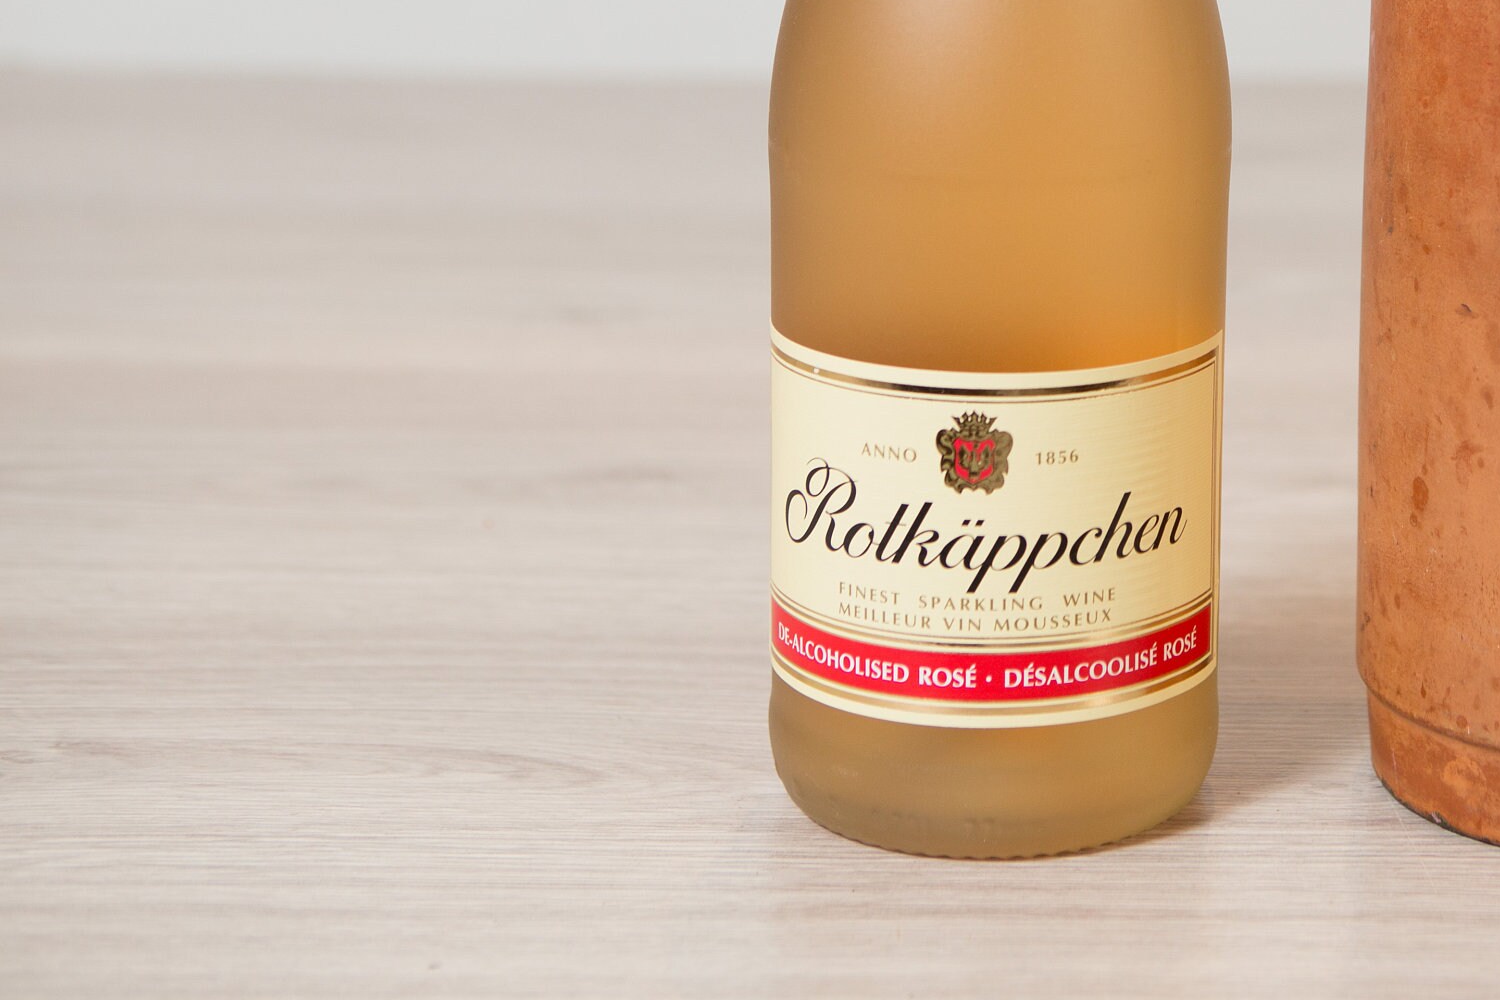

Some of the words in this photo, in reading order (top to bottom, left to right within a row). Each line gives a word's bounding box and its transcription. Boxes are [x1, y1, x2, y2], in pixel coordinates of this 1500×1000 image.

[860, 442, 918, 464] ANNO
[1035, 448, 1080, 467] 1856
[785, 456, 1188, 595] Rotkäppchen
[838, 581, 900, 606] FINEST
[918, 594, 1044, 613] SPARKLING
[1063, 586, 1117, 608] WINE
[838, 601, 931, 630] MEILLEUR
[943, 616, 982, 632] VIN
[993, 607, 1112, 632] MOUSSEUX
[778, 620, 910, 684] DE-ALCOHOLISED
[918, 663, 978, 689] ROSÉ
[1004, 642, 1158, 689] DÉSALCOOLISÉ
[1163, 624, 1198, 662] ROSÉ
